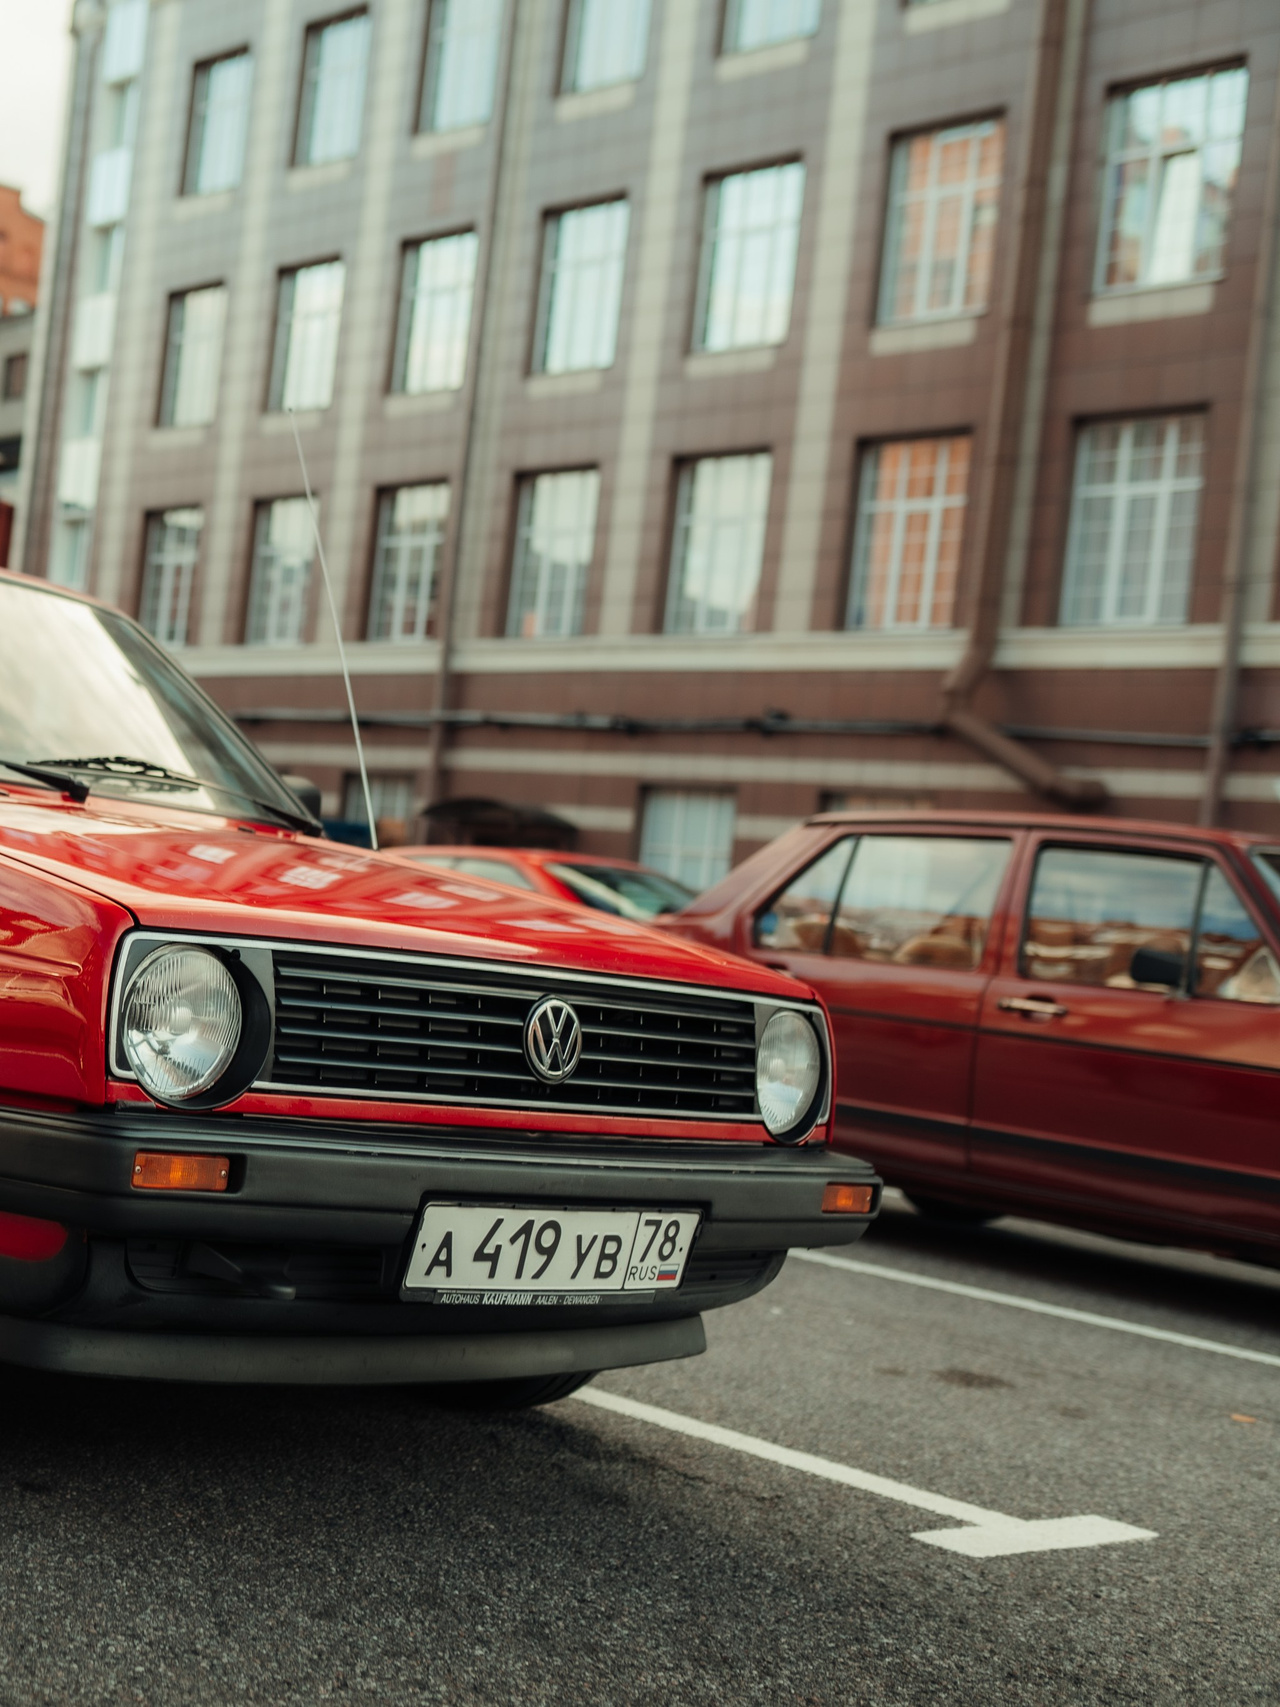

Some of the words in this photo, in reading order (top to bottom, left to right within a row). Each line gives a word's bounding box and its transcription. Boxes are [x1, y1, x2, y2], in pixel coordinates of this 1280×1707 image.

[472, 1217, 562, 1279] 419
[639, 1219, 681, 1263] 78
[628, 1264, 657, 1281] RUS
[440, 1293, 480, 1305] AUTOHAUS
[482, 1292, 534, 1306] KAUFMANN
[535, 1295, 558, 1305] AALEN
[563, 1295, 600, 1305] DEWANGEN
